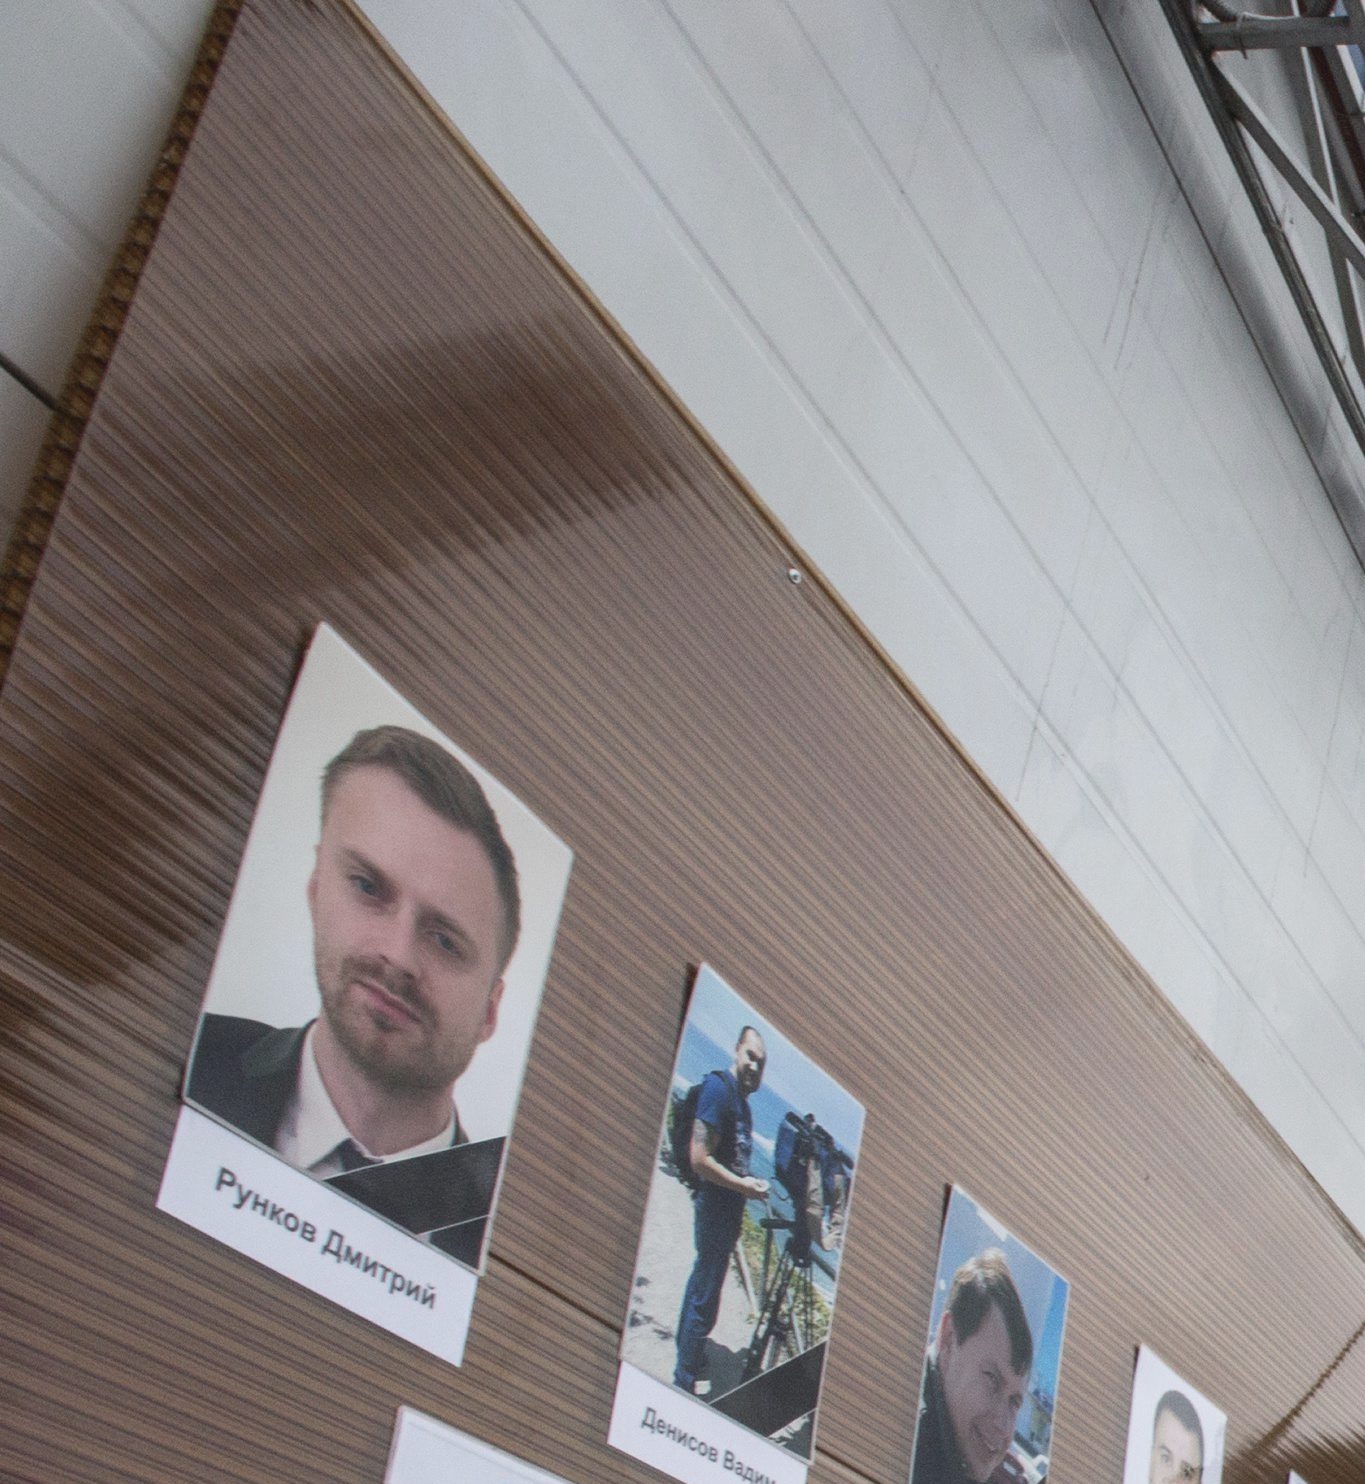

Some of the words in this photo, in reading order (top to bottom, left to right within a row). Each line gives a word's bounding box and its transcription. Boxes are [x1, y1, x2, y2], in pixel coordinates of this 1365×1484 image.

[213, 1165, 317, 1244] Рунков
[321, 1229, 437, 1309] Дмитрий
[641, 1406, 718, 1463] Денисов
